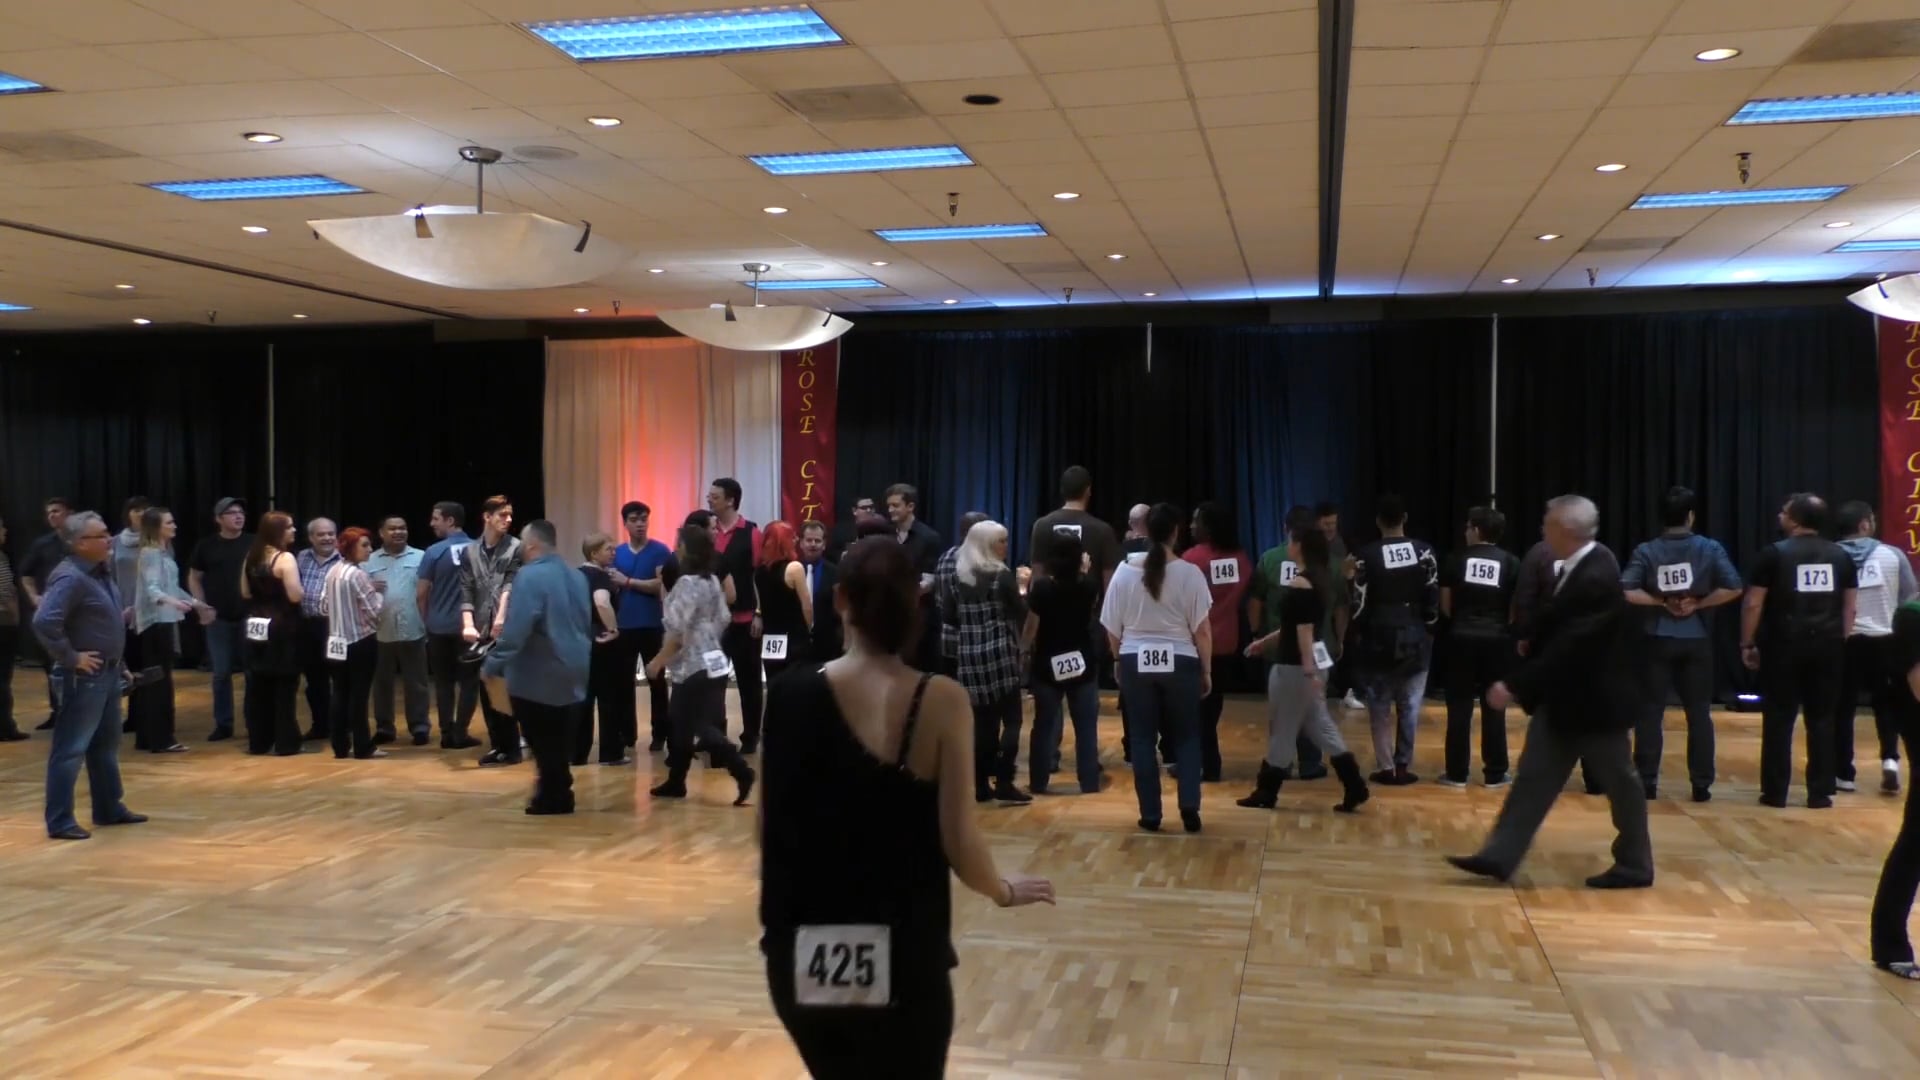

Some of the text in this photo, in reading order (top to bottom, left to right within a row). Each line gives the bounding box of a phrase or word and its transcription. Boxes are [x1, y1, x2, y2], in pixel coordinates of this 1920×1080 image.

[798, 349, 821, 522] ROSE CIT
[1388, 547, 1411, 563] 153
[1215, 564, 1234, 579] 148
[1471, 563, 1495, 579] 158
[1664, 568, 1688, 585] 169
[1804, 570, 1828, 586] 173
[765, 639, 784, 654] 497
[1056, 656, 1081, 675] 233
[1143, 649, 1168, 666] 384
[808, 943, 876, 988] 425
